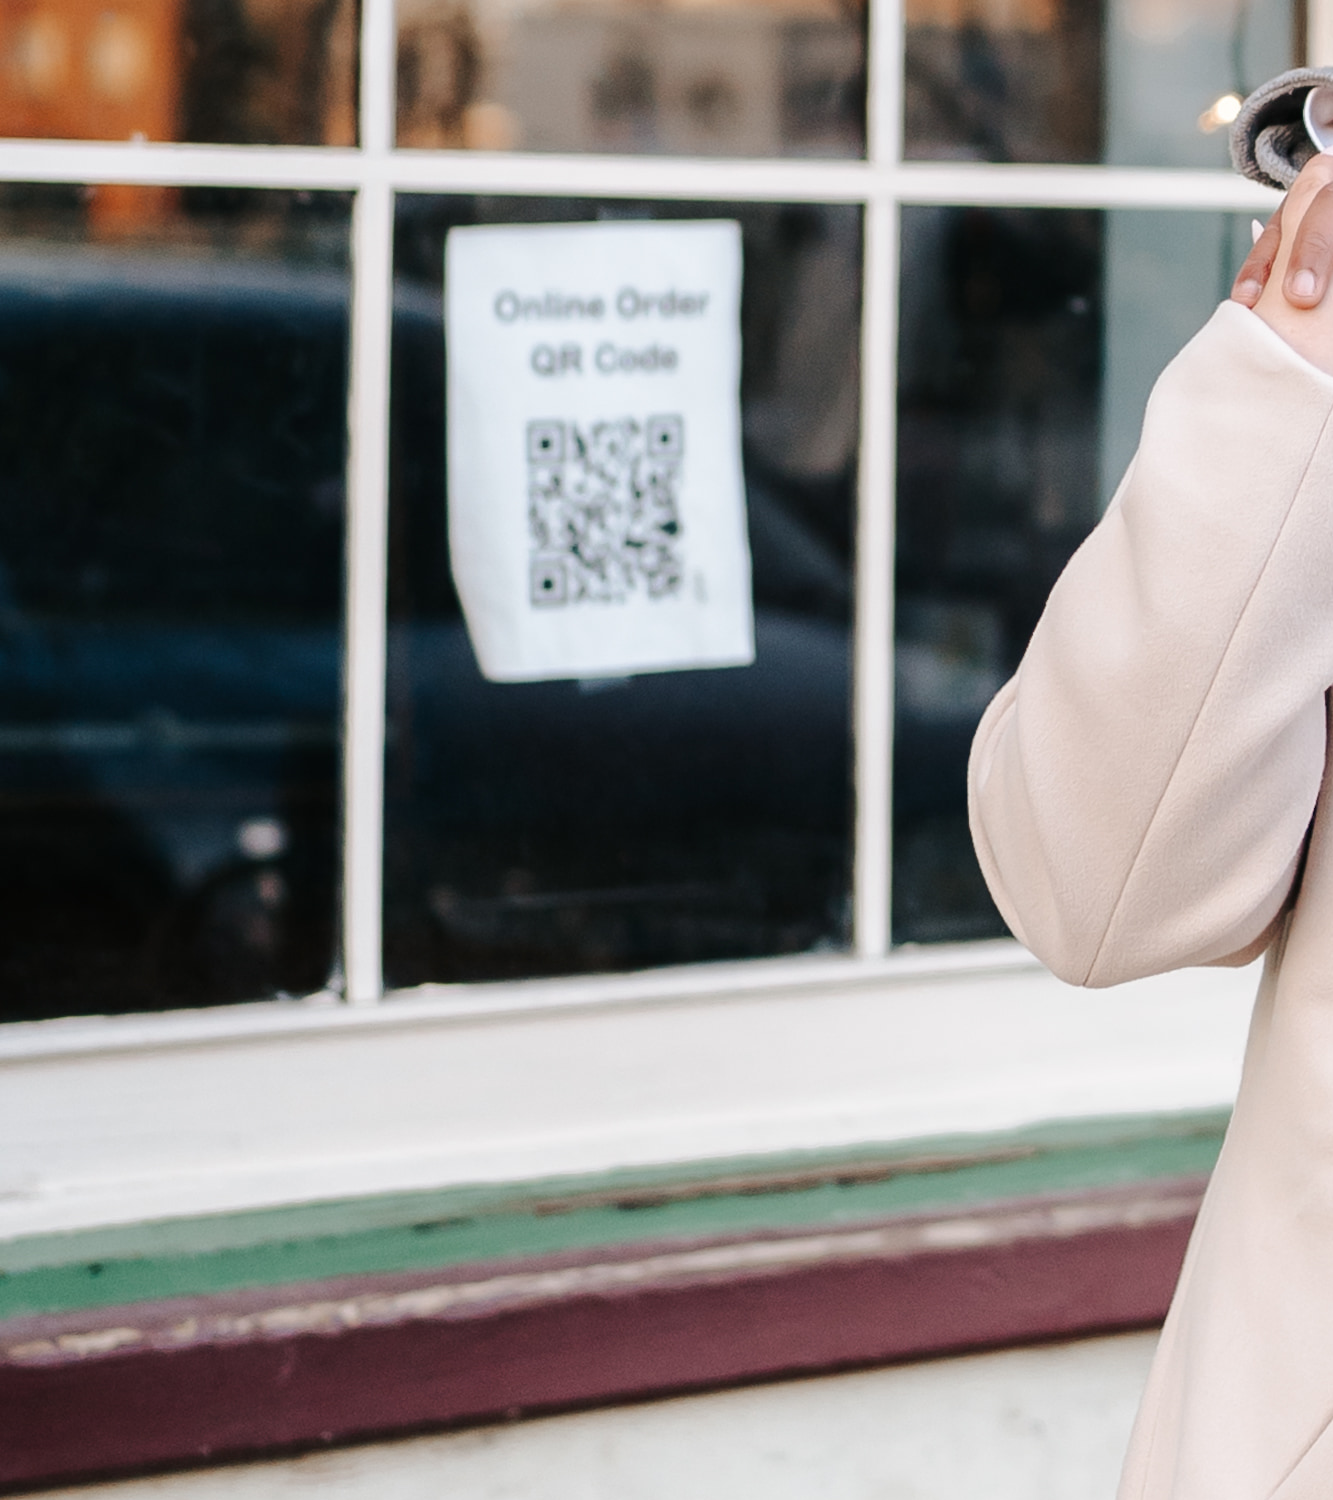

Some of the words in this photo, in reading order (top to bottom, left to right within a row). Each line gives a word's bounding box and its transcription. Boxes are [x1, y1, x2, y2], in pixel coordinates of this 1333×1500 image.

[494, 287, 604, 323] Online
[616, 285, 710, 320] Order
[531, 343, 583, 376] QR
[595, 343, 679, 373] Code
